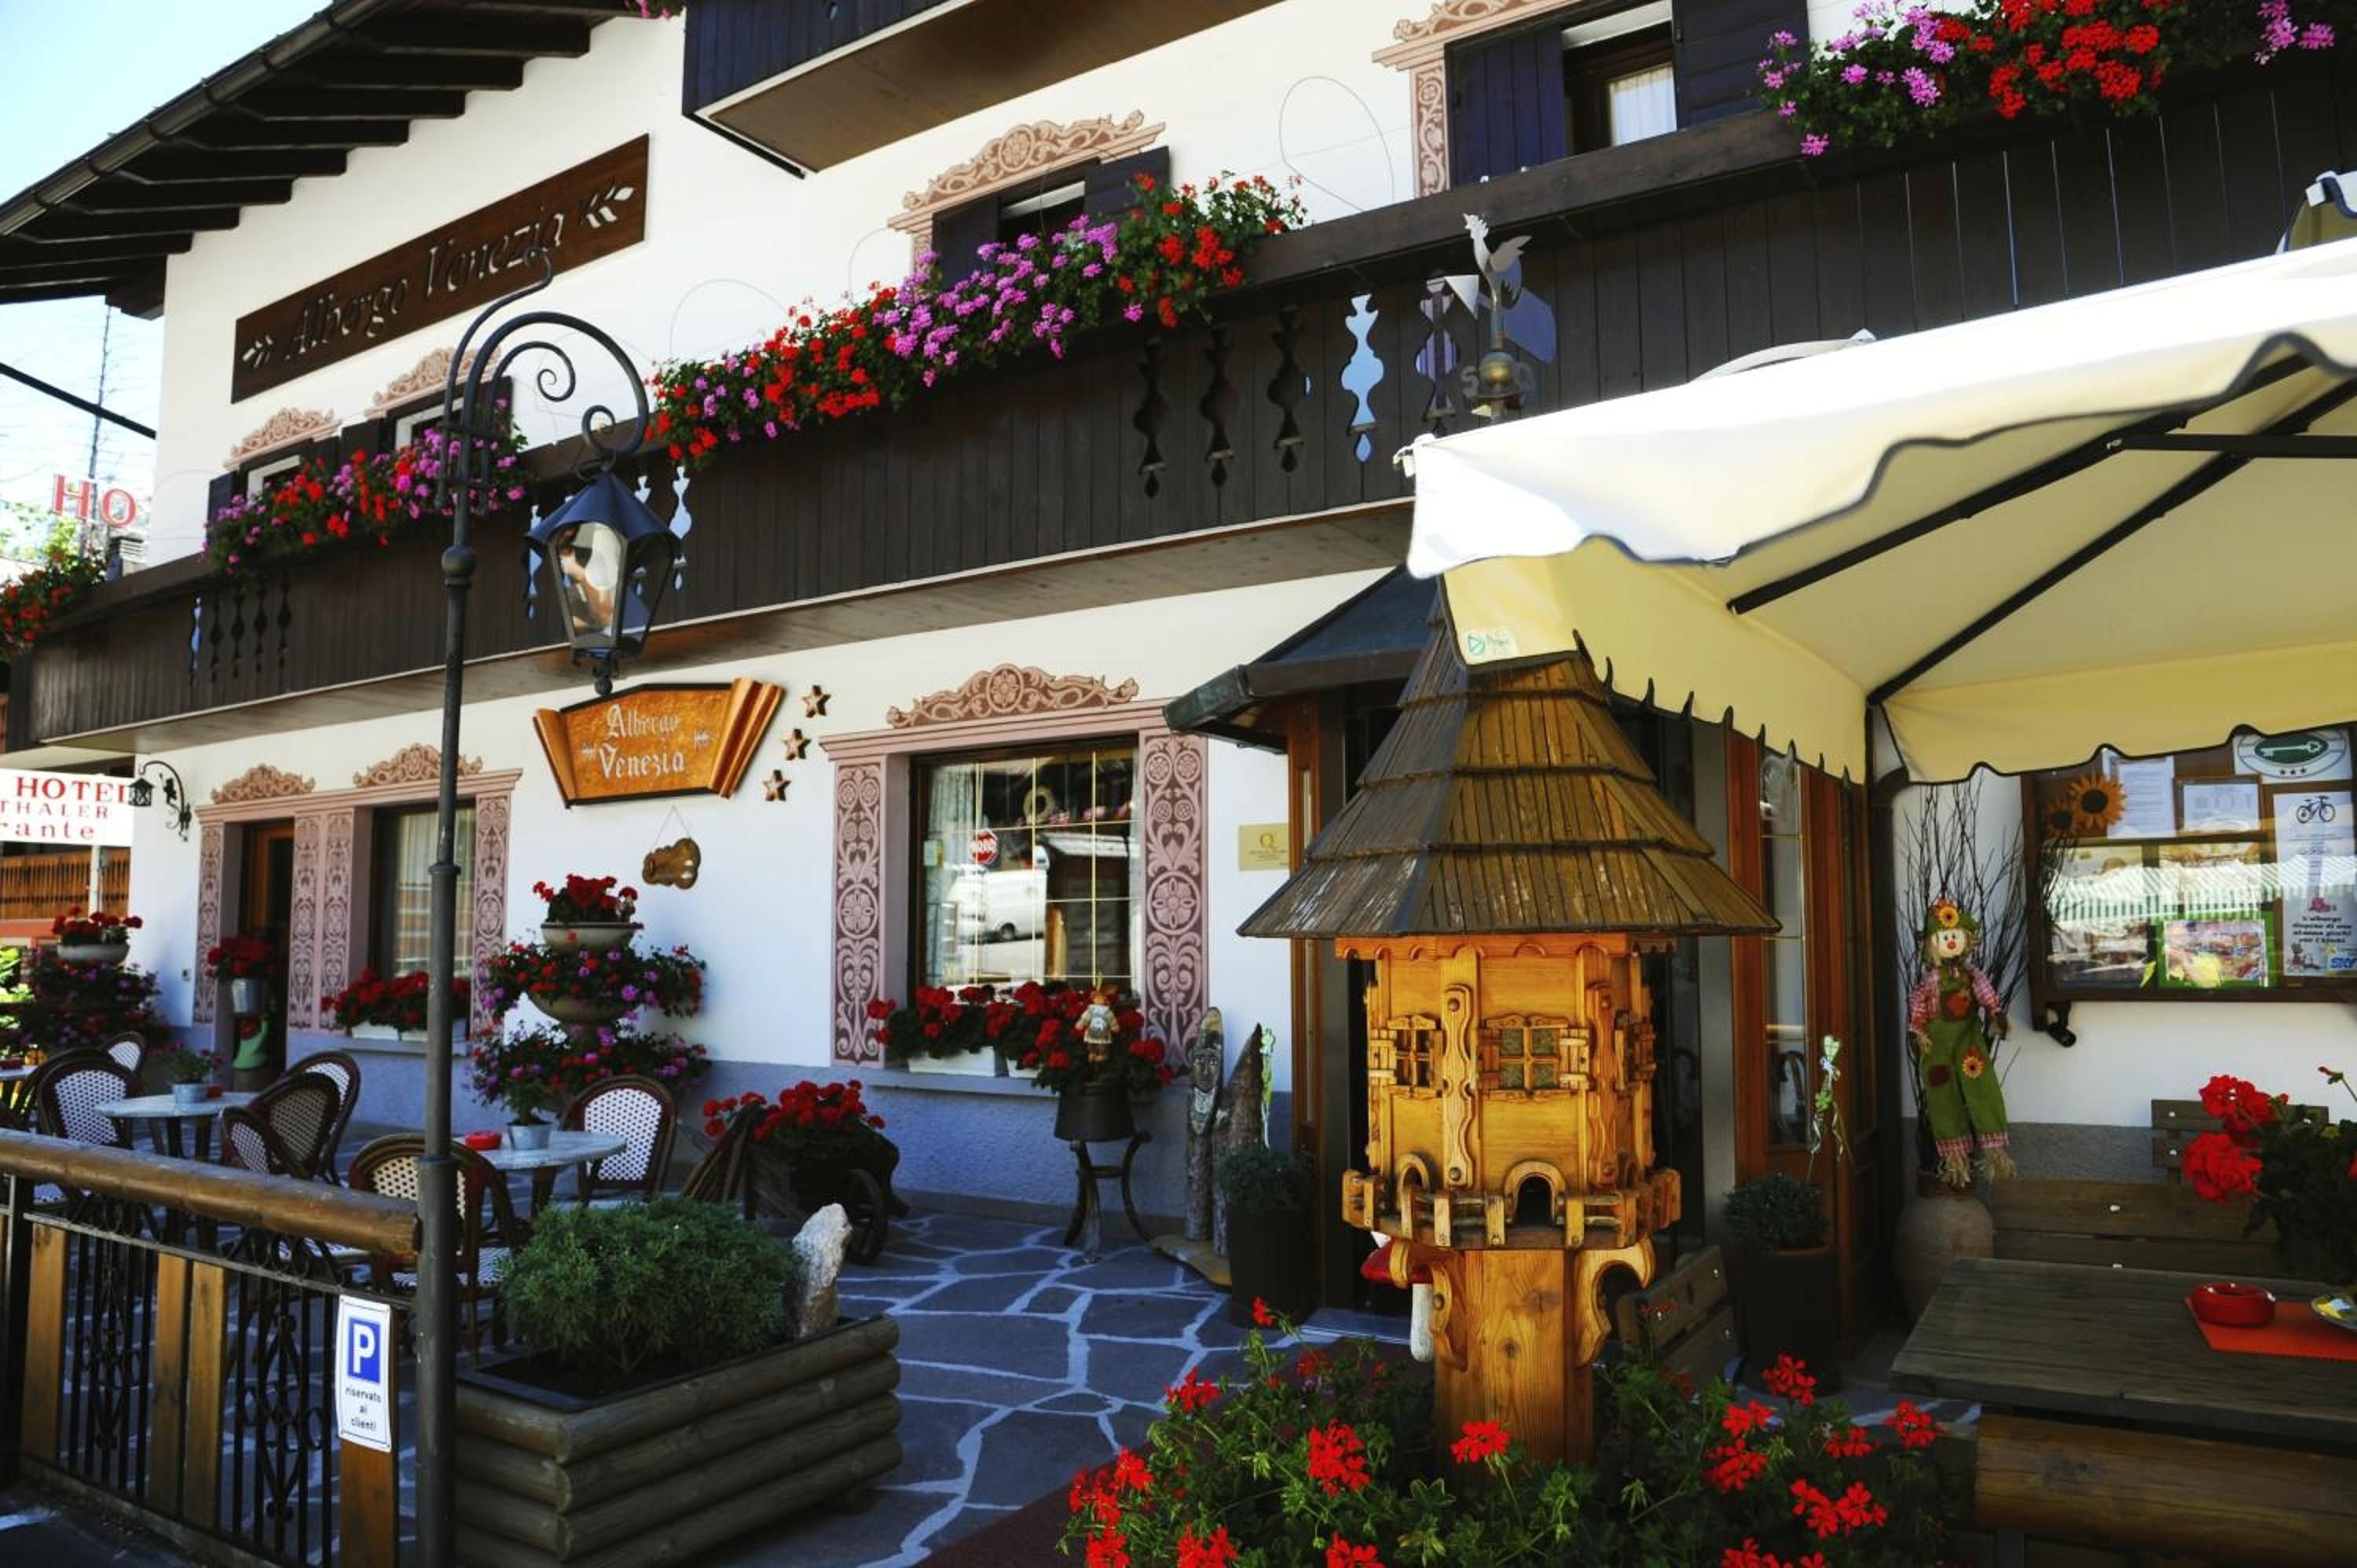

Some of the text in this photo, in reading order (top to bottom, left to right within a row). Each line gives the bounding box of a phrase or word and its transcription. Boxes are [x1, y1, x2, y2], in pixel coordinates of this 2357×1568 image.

[284, 203, 566, 360] Albergo Venezia
[53, 472, 138, 528] HO
[603, 703, 680, 742] Albergo
[599, 742, 685, 780] Venezia
[354, 1324, 376, 1375] P
[345, 1387, 381, 1403] riservato
[359, 1404, 368, 1414] ai
[350, 1416, 377, 1431] clienti
